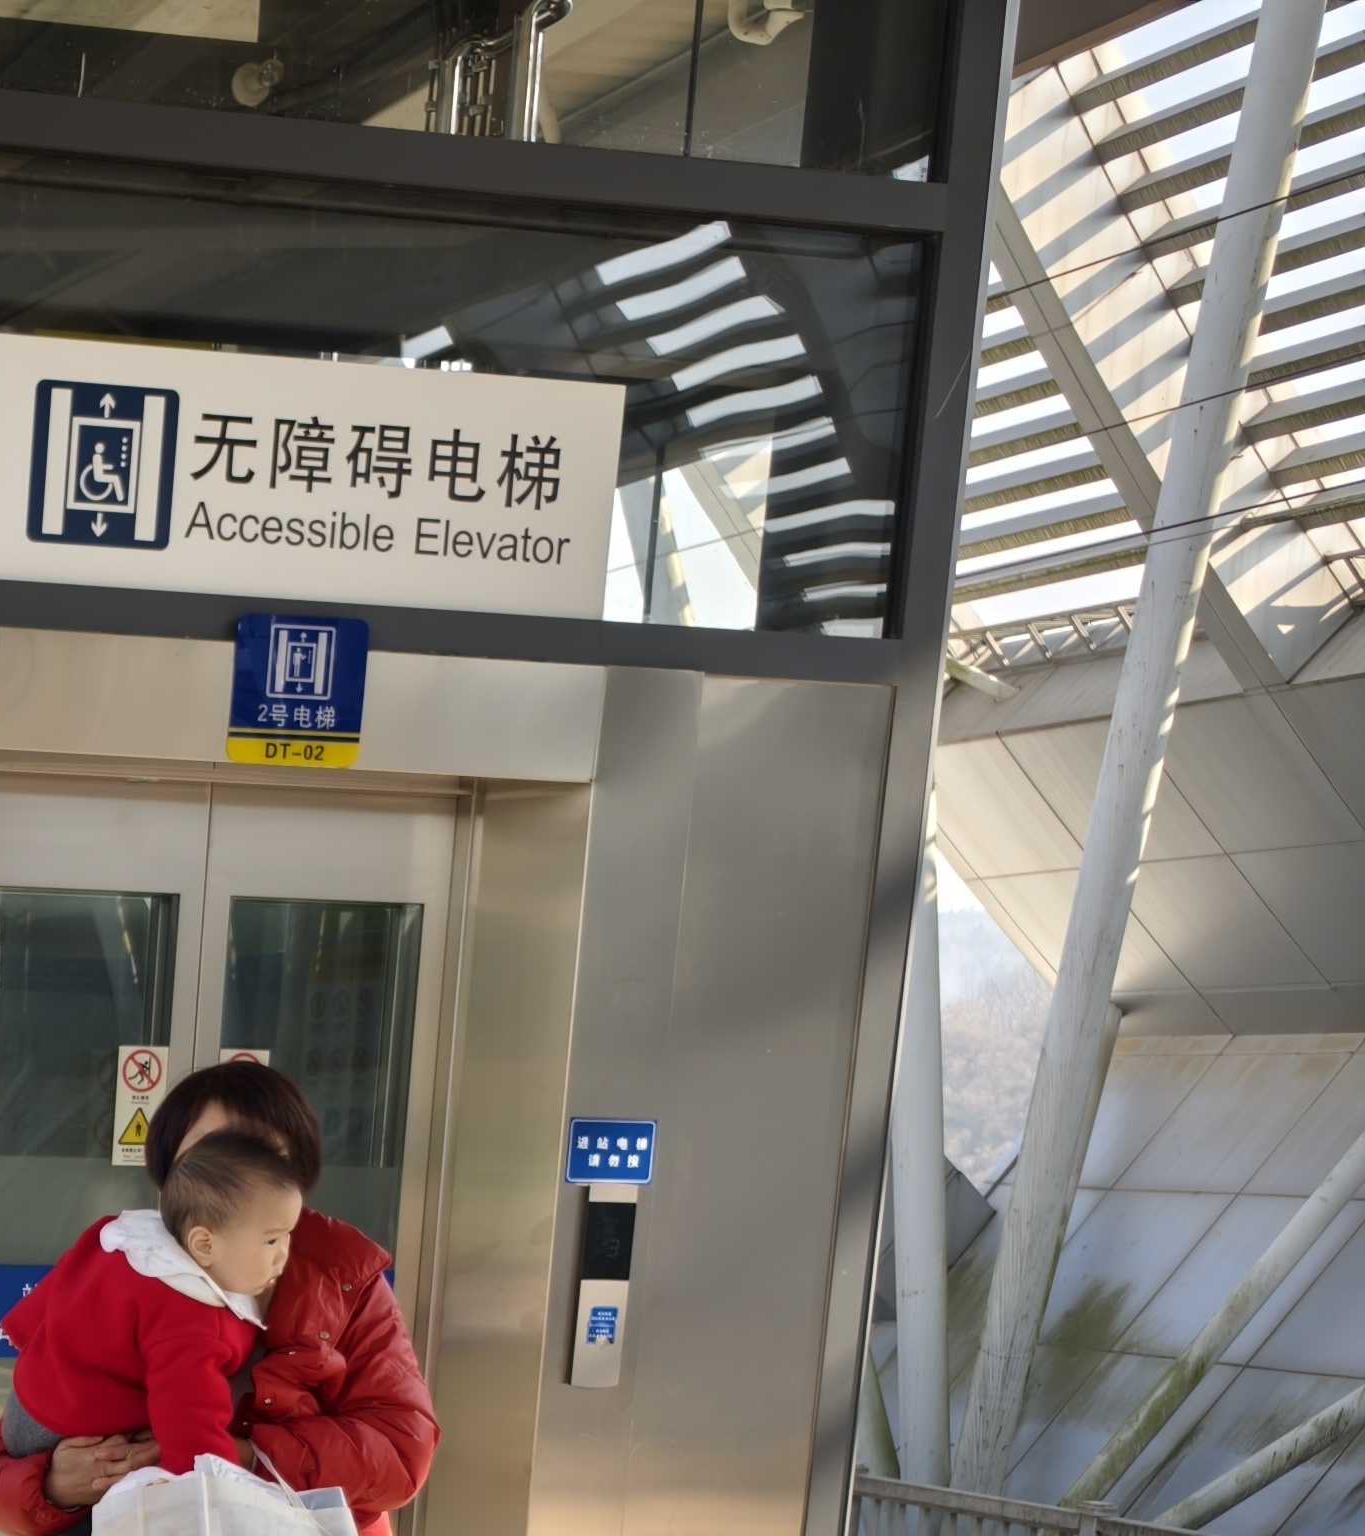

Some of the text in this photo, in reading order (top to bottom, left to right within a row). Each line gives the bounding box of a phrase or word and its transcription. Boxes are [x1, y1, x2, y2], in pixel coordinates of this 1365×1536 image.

[189, 411, 562, 511] 无障碍电梯
[185, 501, 571, 566] Accessible Elevator
[256, 703, 336, 730] 2号电梯
[264, 742, 325, 762] DT-02
